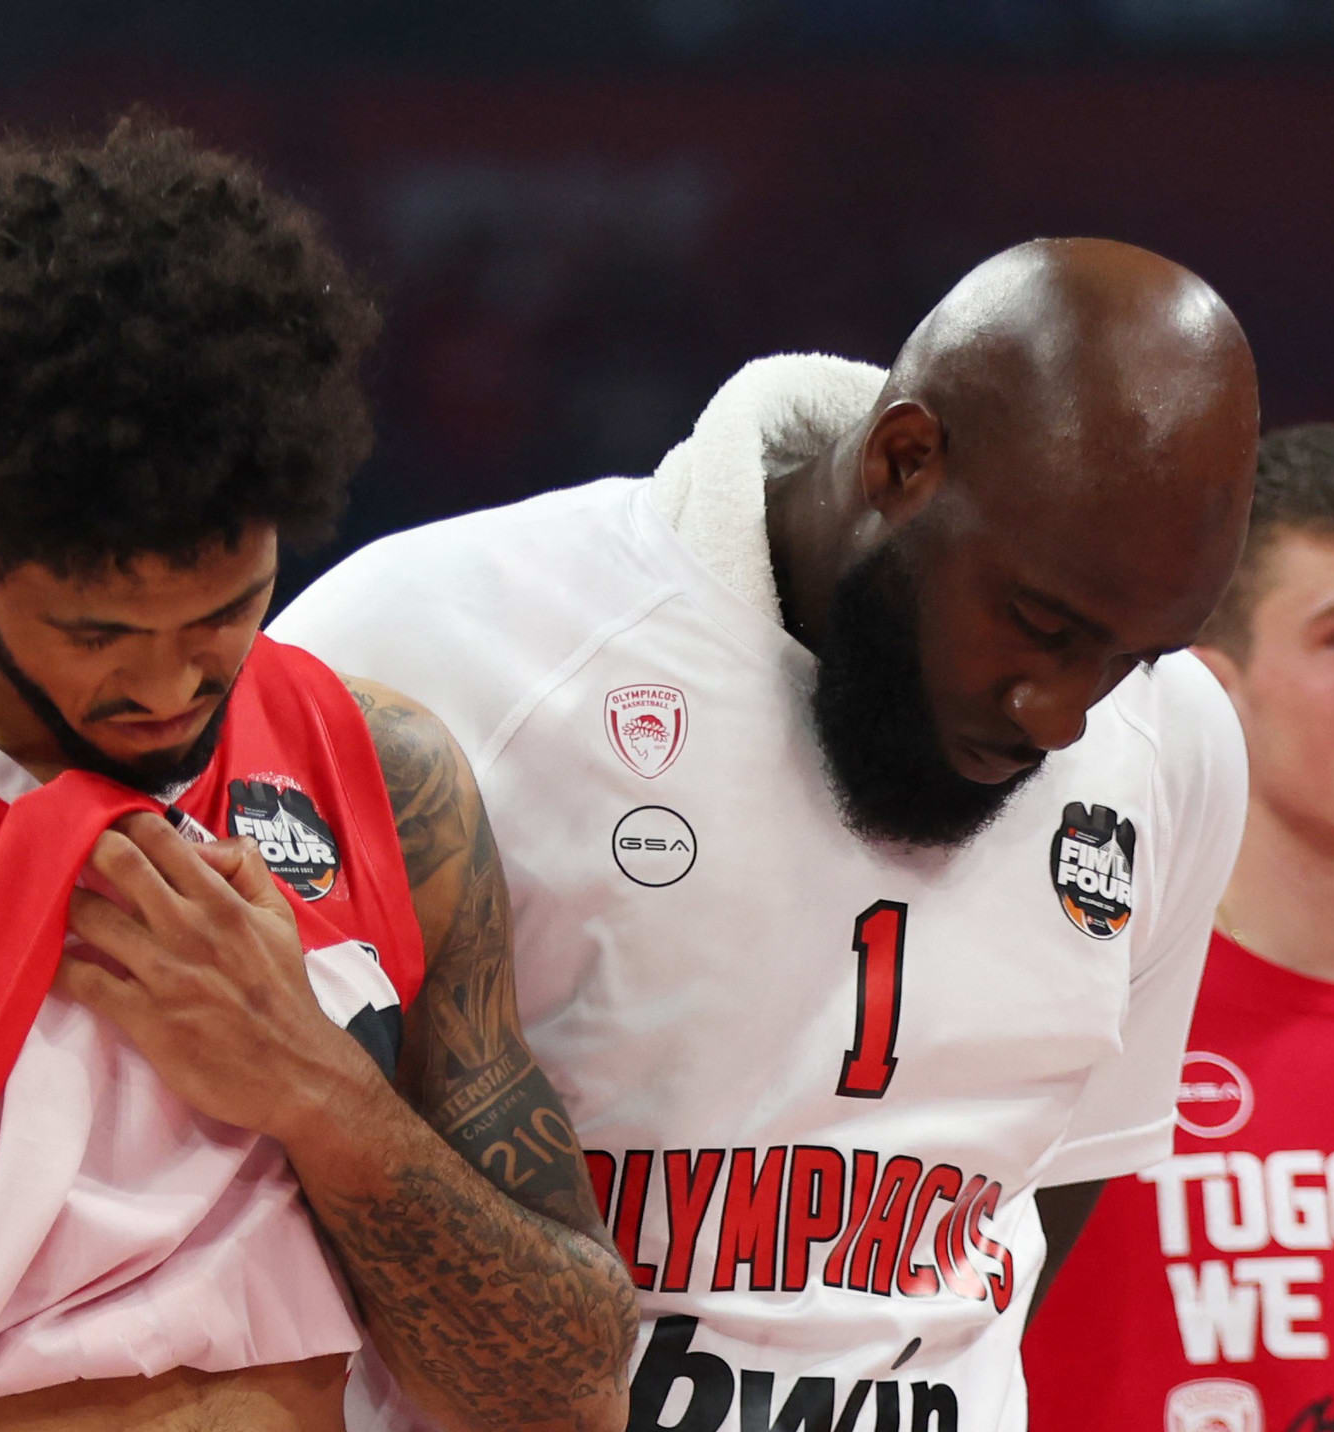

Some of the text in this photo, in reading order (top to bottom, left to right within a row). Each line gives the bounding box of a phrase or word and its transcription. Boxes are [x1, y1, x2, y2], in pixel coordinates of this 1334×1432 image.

[611, 689, 678, 704] OLYMPIACOS
[621, 700, 669, 710] BASKETBALL
[234, 813, 320, 843] FINAL
[619, 837, 690, 852] GSA
[258, 840, 336, 865] OUR
[1058, 836, 1131, 884] FINAL
[1057, 860, 1132, 909] FOUR
[835, 898, 908, 1099] 1
[480, 1106, 580, 1188] 210
[1165, 1256, 1330, 1365] WE
